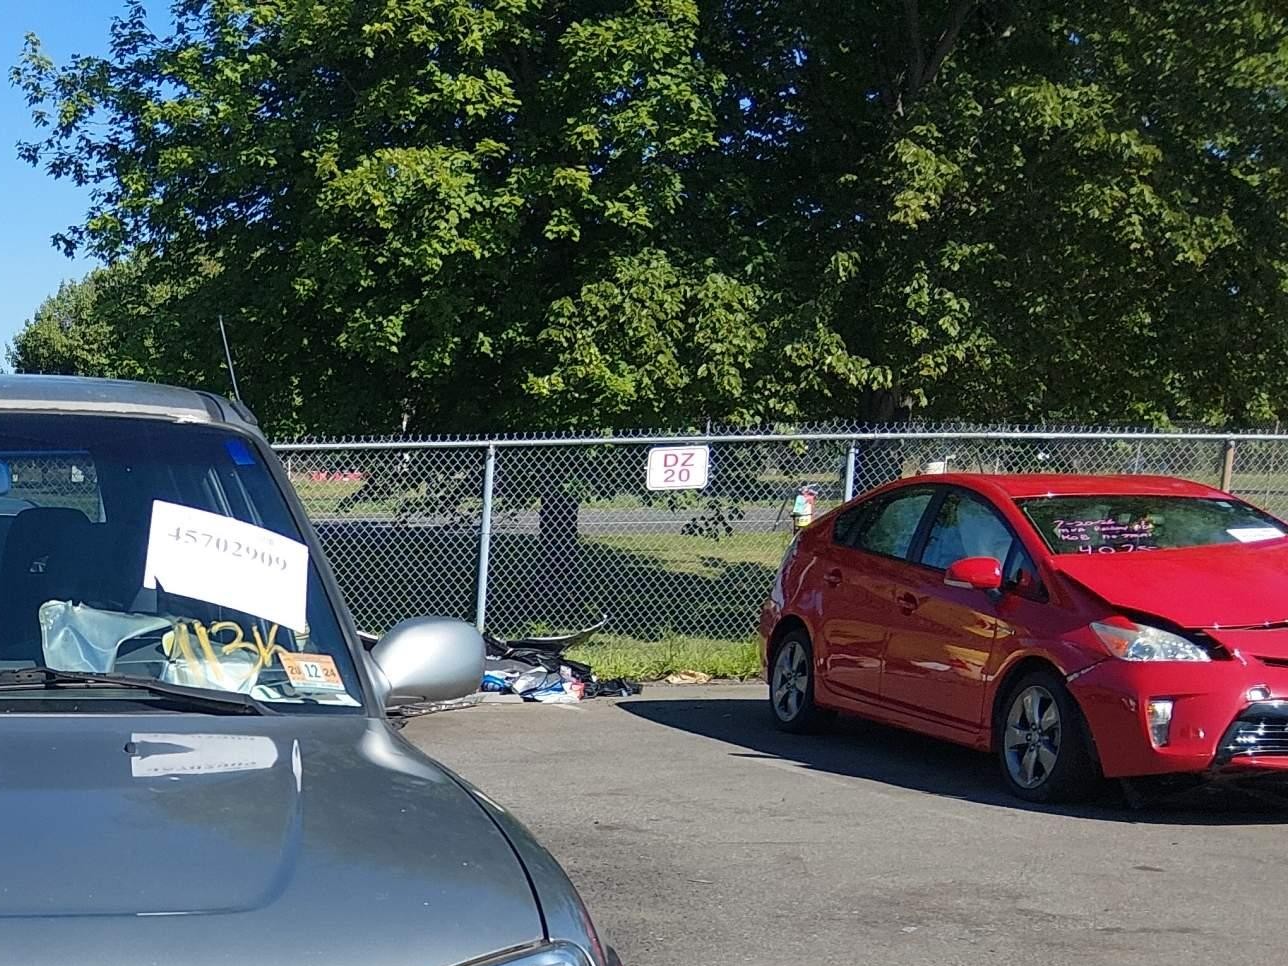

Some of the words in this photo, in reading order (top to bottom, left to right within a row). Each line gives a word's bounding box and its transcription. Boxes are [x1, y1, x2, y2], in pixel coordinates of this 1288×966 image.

[663, 453, 695, 468] DZ
[663, 468, 691, 483] 20
[168, 527, 288, 571] 45702909
[304, 663, 321, 679] 12
